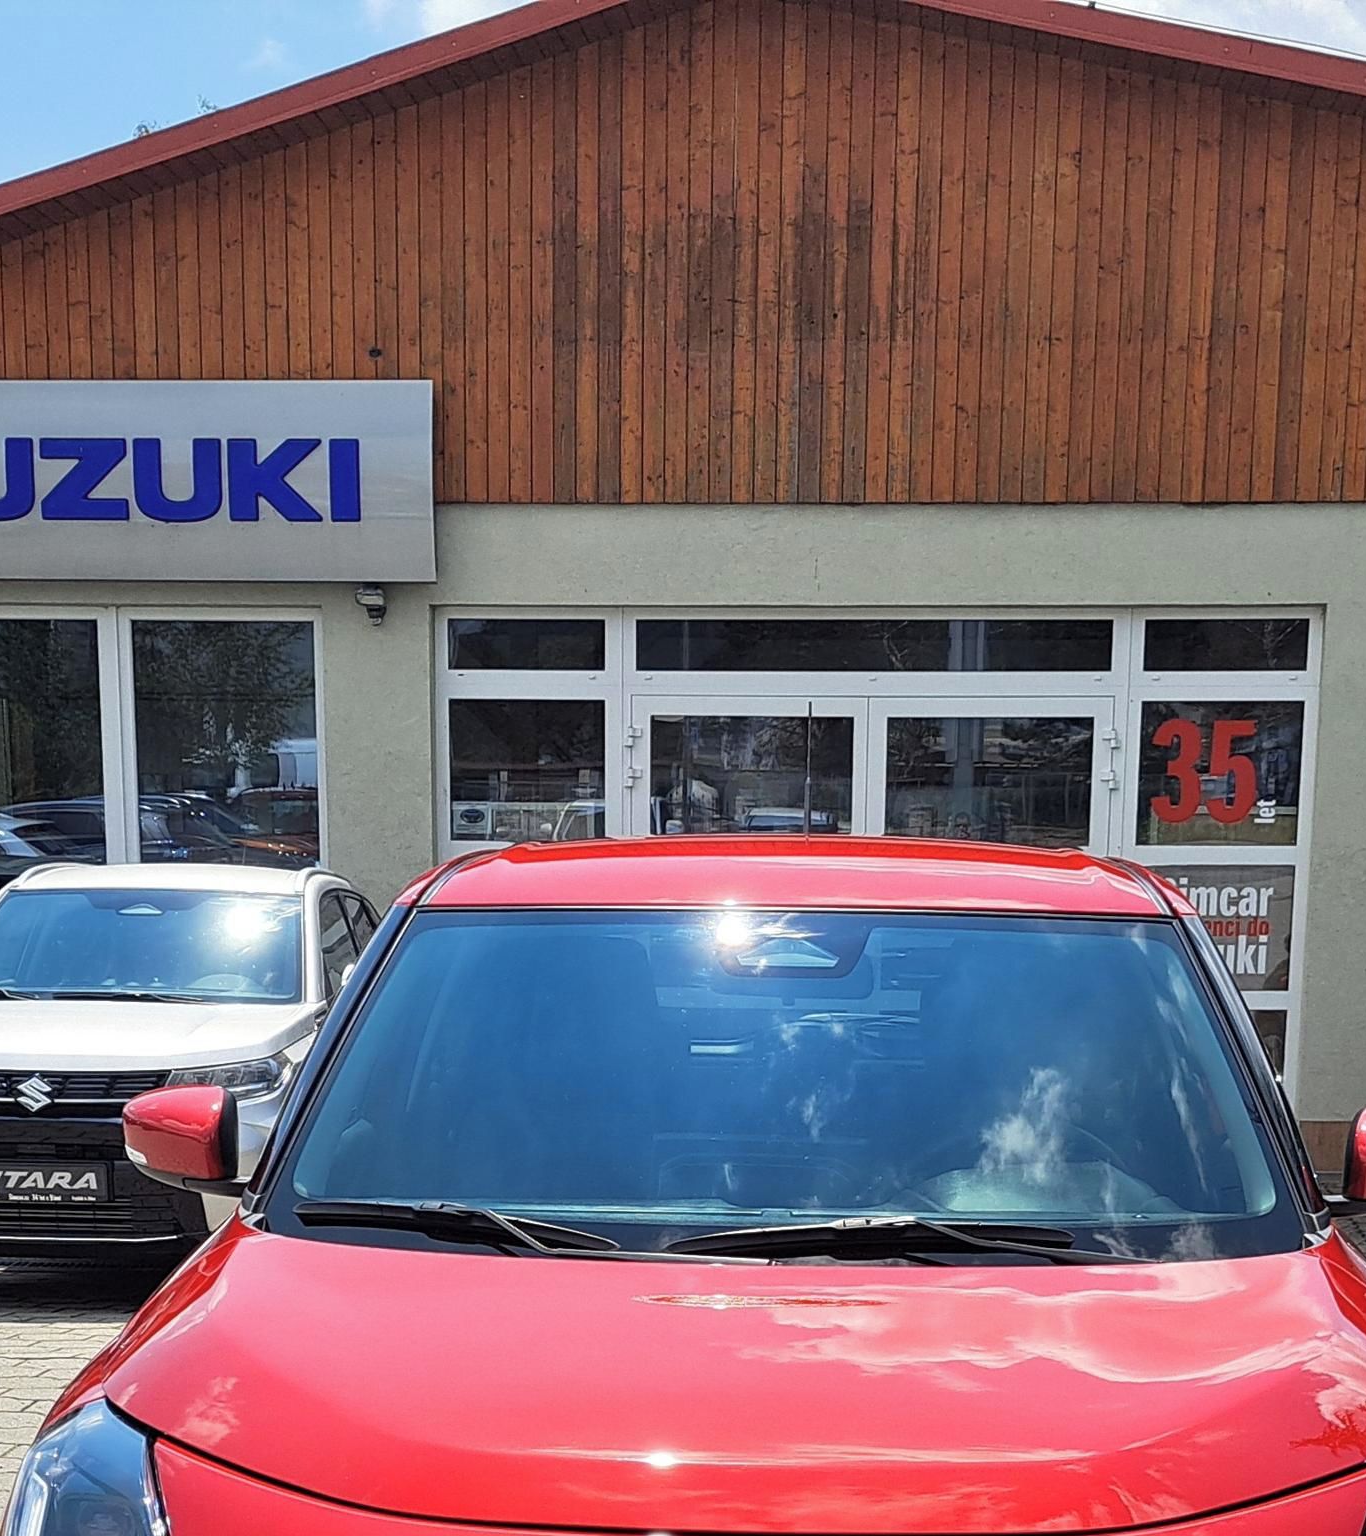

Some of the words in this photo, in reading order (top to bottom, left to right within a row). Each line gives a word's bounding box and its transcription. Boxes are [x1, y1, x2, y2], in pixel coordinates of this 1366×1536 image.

[1151, 719, 1258, 824] 35
[1254, 799, 1276, 824] let
[1165, 877, 1274, 917] mcar
[1247, 917, 1270, 937] do
